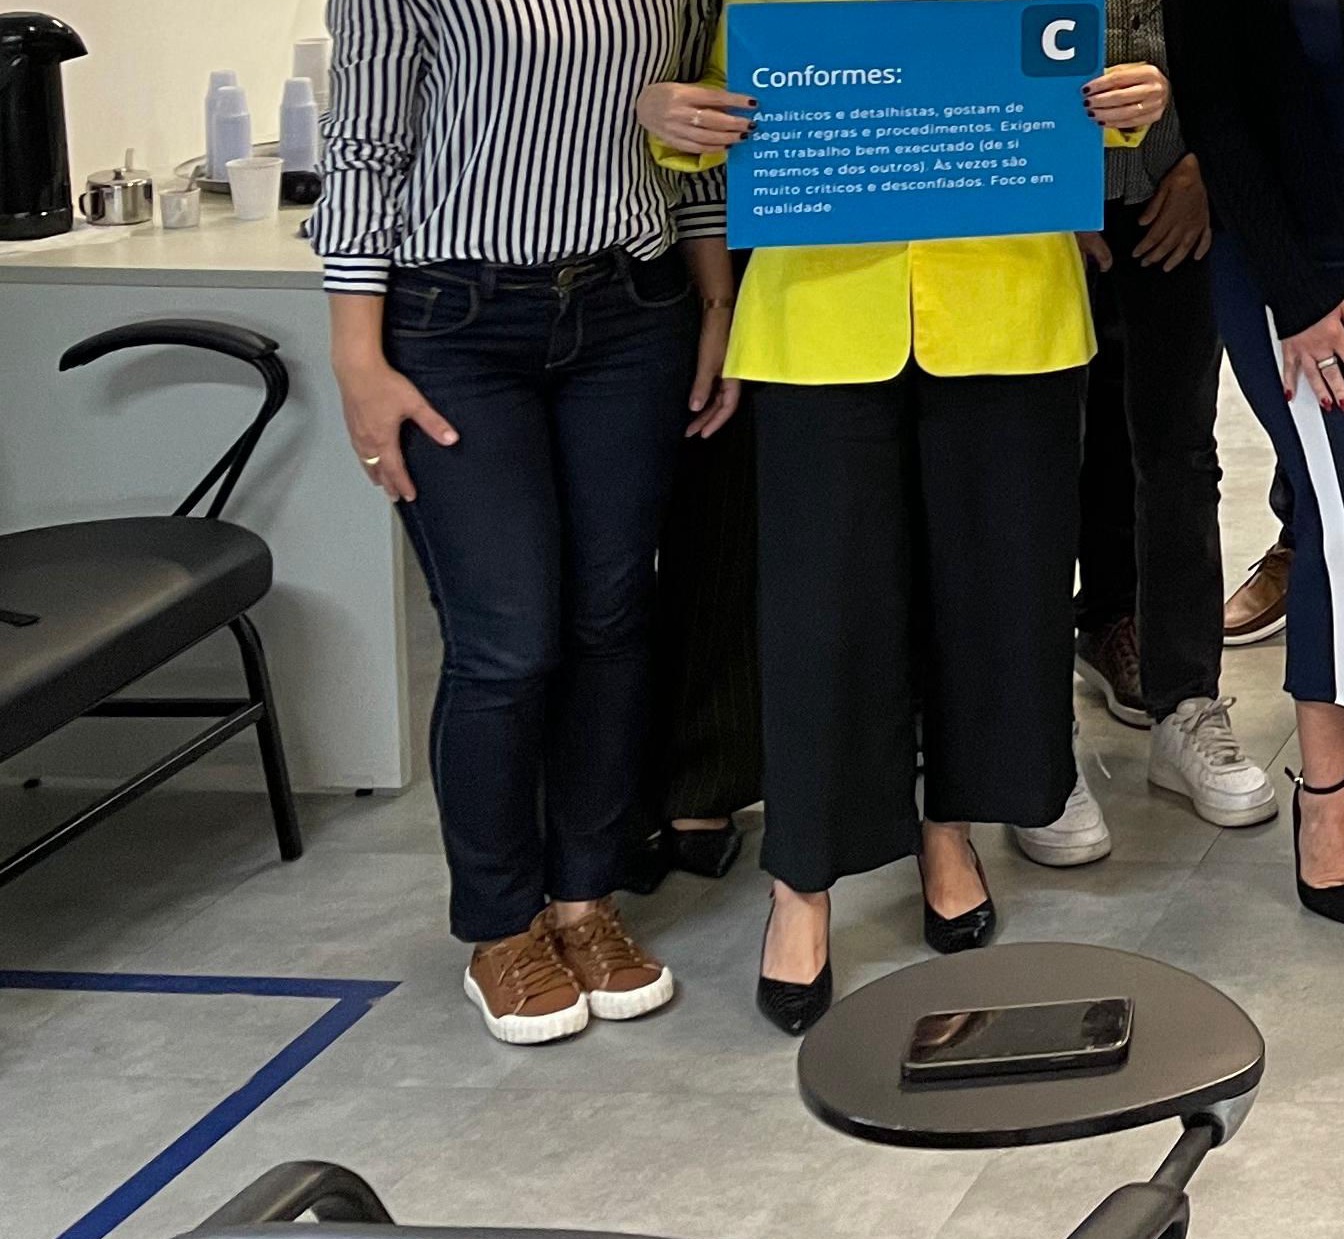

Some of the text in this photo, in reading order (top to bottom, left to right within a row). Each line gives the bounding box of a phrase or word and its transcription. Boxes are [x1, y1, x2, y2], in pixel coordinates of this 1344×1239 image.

[1041, 19, 1077, 61] C
[752, 65, 902, 89] Conformes:
[836, 111, 845, 119] e
[850, 108, 938, 119] detalhistas,
[944, 106, 1000, 117] gostam
[1005, 103, 1024, 113] de
[752, 130, 801, 142] seguir
[808, 129, 857, 141] regras
[862, 129, 871, 137] e
[1001, 121, 1055, 132] Exigem
[754, 140, 1019, 159] um trabalho bem executado (de si
[754, 168, 819, 177] mesmos
[824, 167, 833, 175] e
[838, 164, 865, 174] dos
[934, 159, 952, 170] Às
[956, 160, 997, 169] vezes
[1002, 157, 1027, 167] são
[754, 186, 800, 195] muito
[867, 184, 876, 192] e
[991, 175, 1026, 185] Foco
[1031, 175, 1053, 183] em
